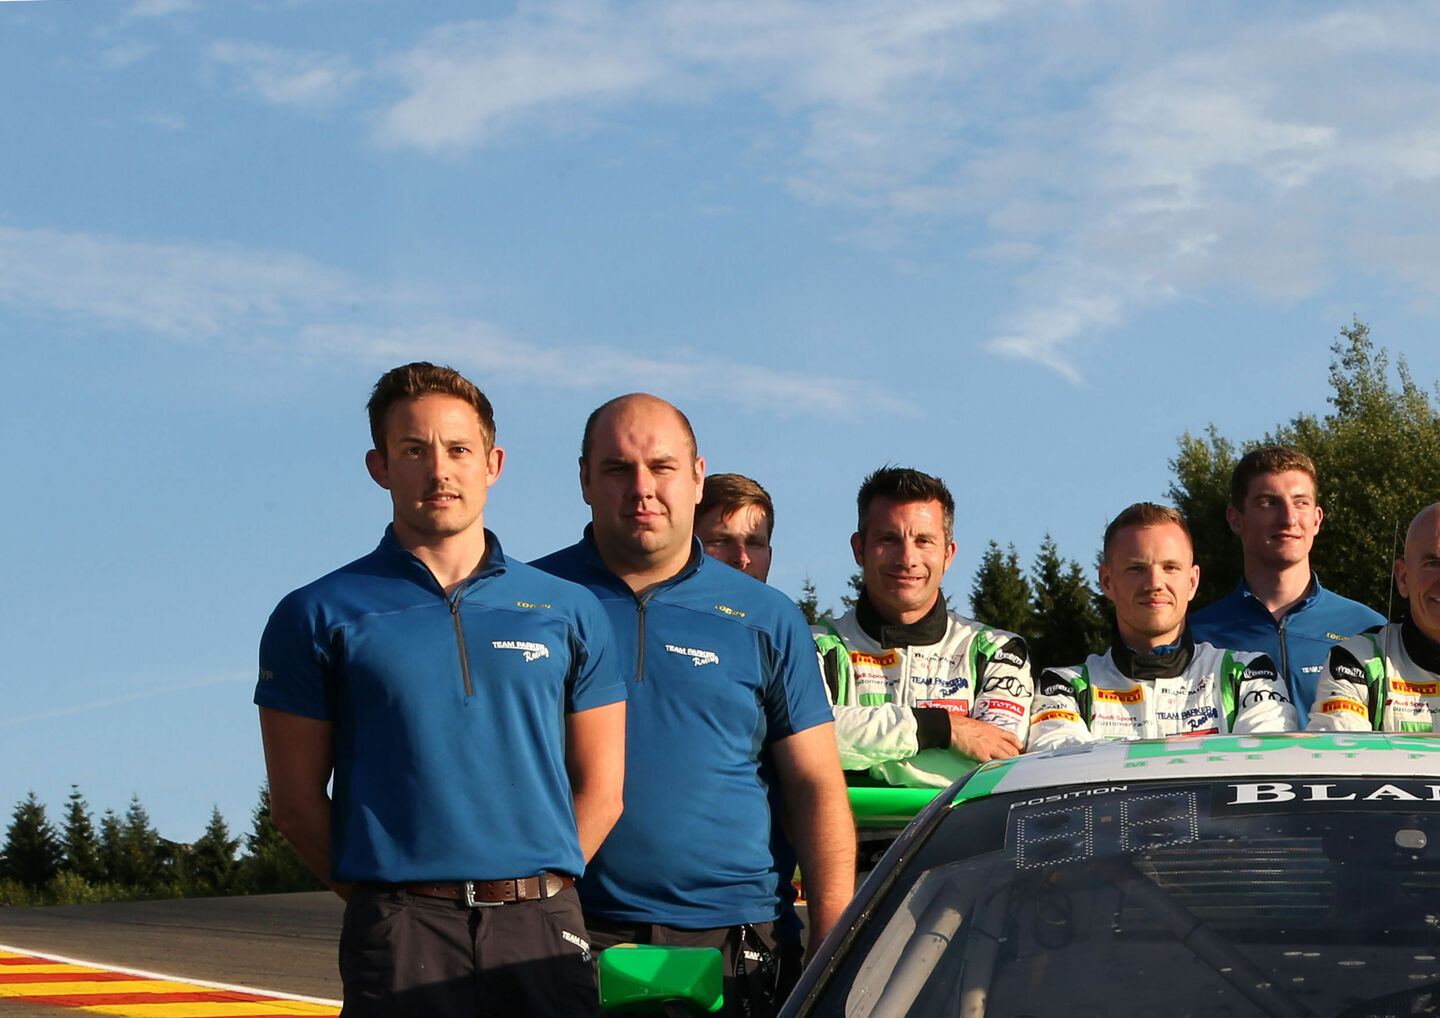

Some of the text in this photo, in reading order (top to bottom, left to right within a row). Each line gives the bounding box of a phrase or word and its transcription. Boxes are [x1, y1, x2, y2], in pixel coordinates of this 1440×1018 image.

[492, 641, 546, 653] TEAM PARKER
[665, 645, 716, 660] TEAM PARKER
[1302, 665, 1320, 674] TEAM
[911, 675, 932, 687] TEAM
[991, 701, 1024, 715] TOTAL
[1157, 705, 1213, 720] TEAM PARKER
[1124, 752, 1263, 768] MAKE
[1010, 786, 1128, 809] POSITION
[562, 930, 581, 945] TEAM
